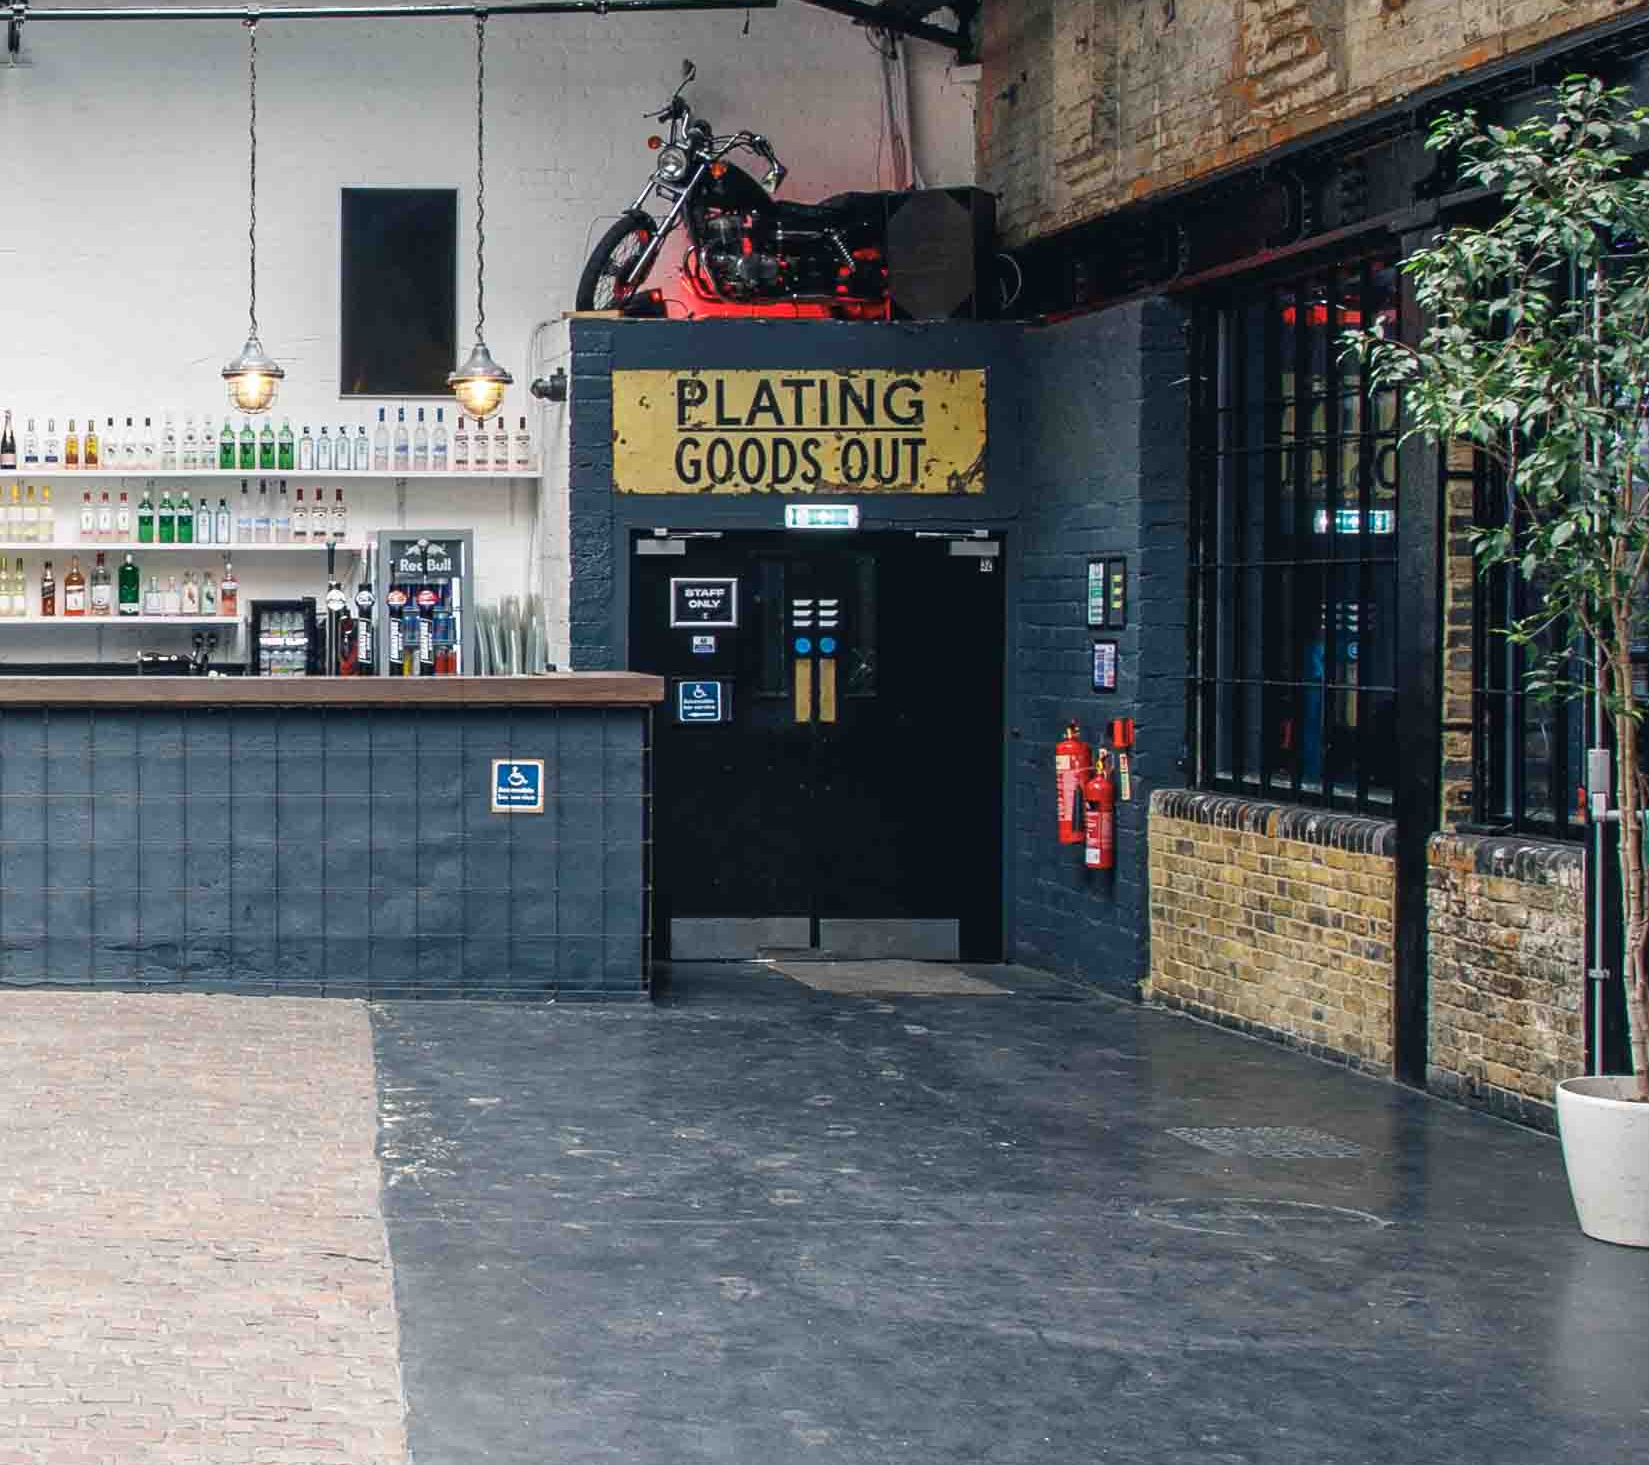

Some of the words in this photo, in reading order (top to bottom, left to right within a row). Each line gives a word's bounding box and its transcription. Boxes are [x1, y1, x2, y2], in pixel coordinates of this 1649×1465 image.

[677, 378, 926, 426] PLATING
[675, 437, 822, 485] GOODS
[841, 437, 926, 485] OUT
[427, 558, 452, 572] Bull
[684, 588, 725, 597] STAFF
[688, 599, 721, 608] ONLY
